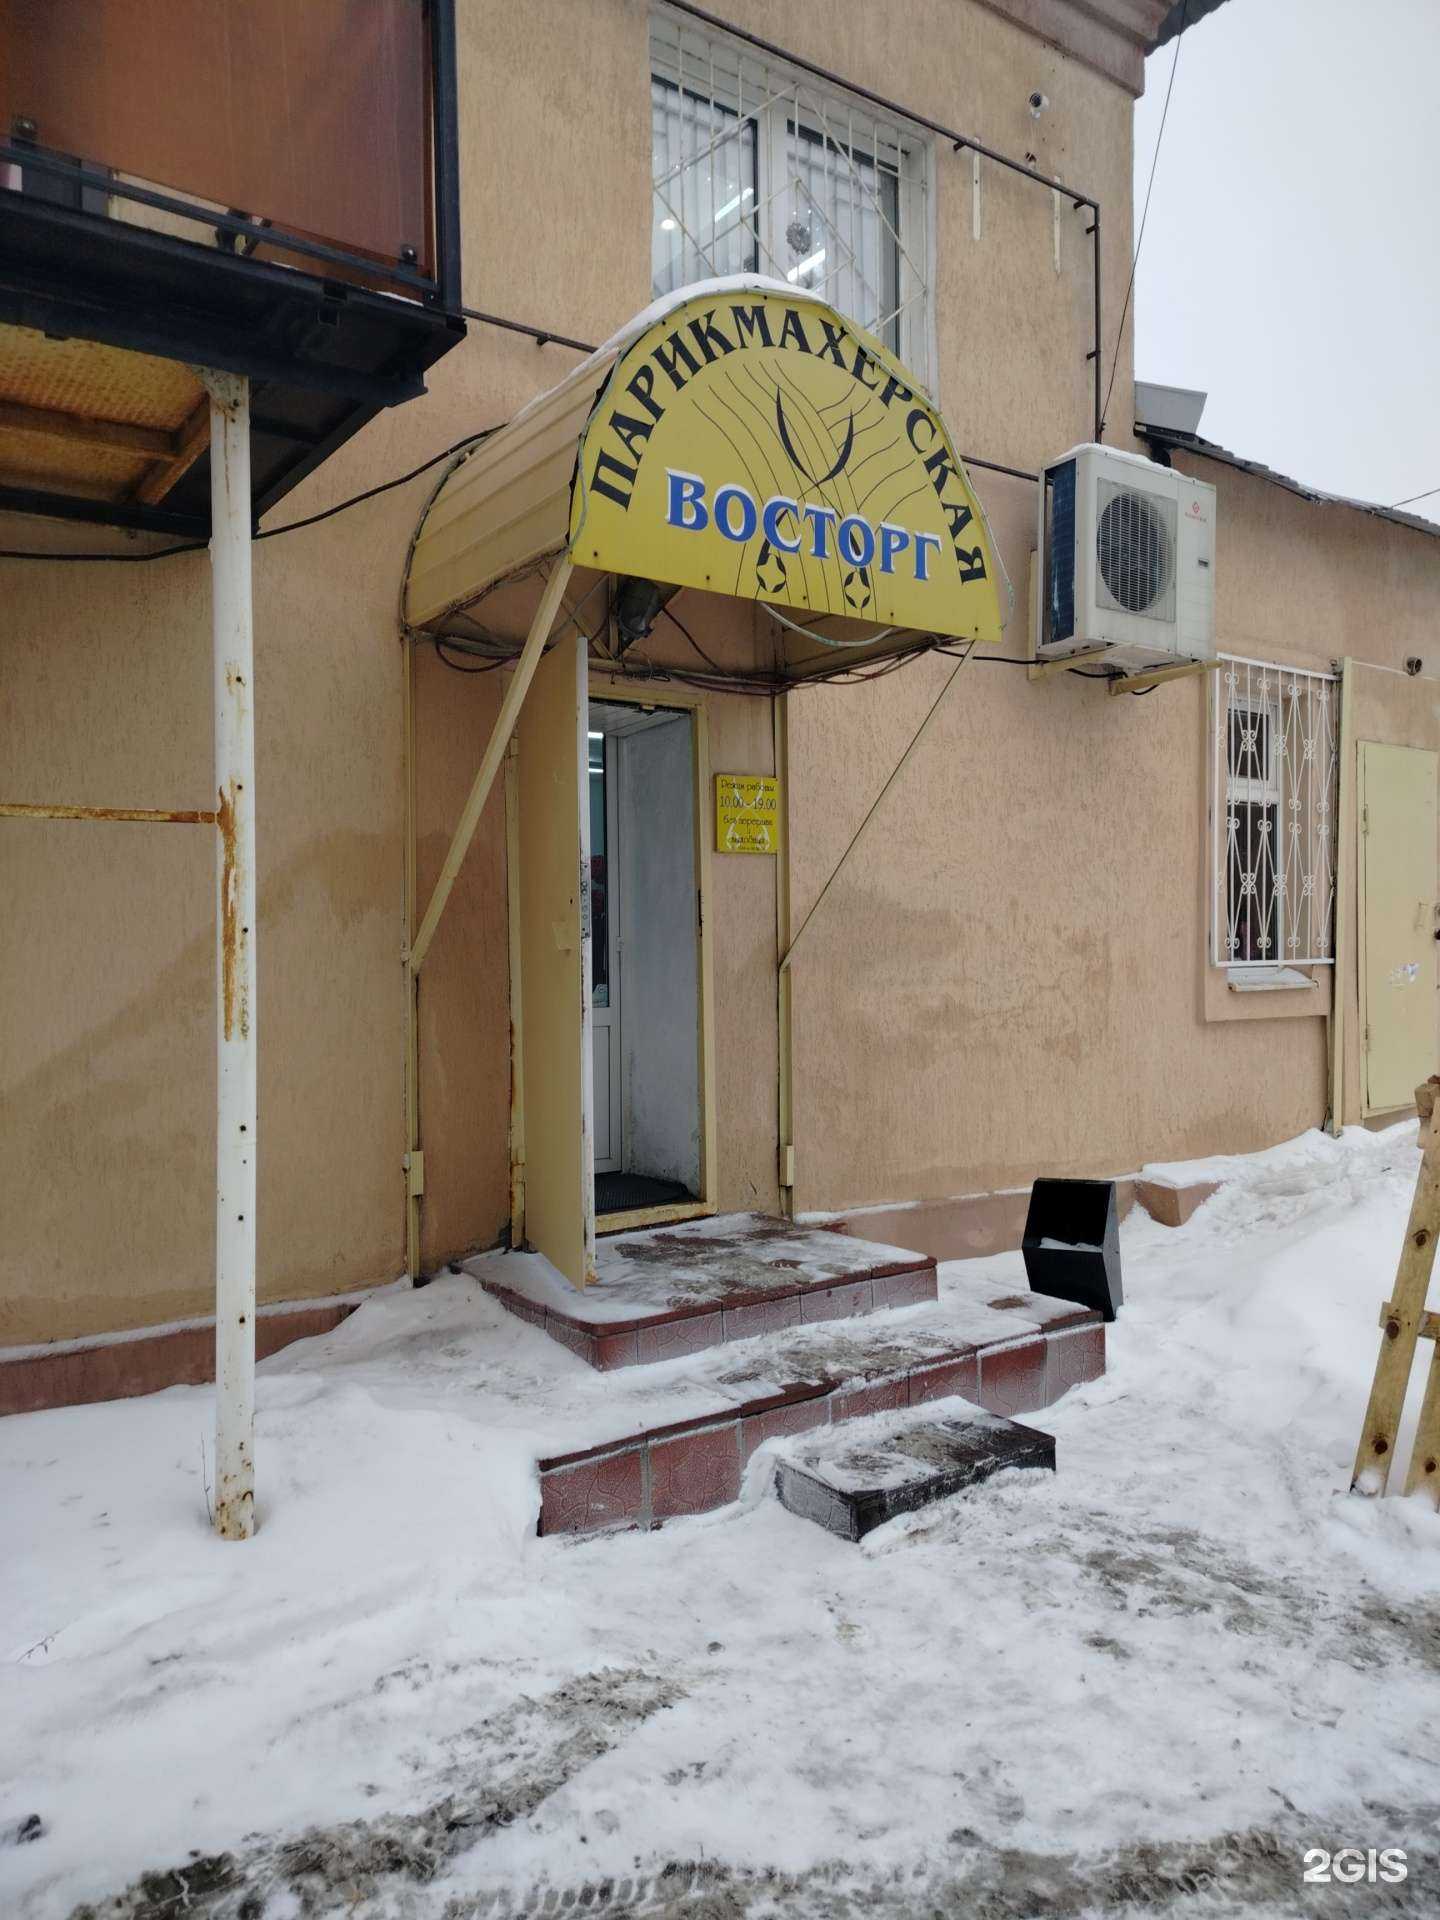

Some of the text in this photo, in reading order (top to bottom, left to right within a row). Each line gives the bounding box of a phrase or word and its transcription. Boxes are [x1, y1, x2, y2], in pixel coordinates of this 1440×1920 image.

[590, 305, 987, 584] ПАРИКМАХЕРСКАЯ
[664, 467, 942, 581] ВОСТОРГ
[720, 796, 744, 808] 10.00
[753, 798, 776, 809] 19.00
